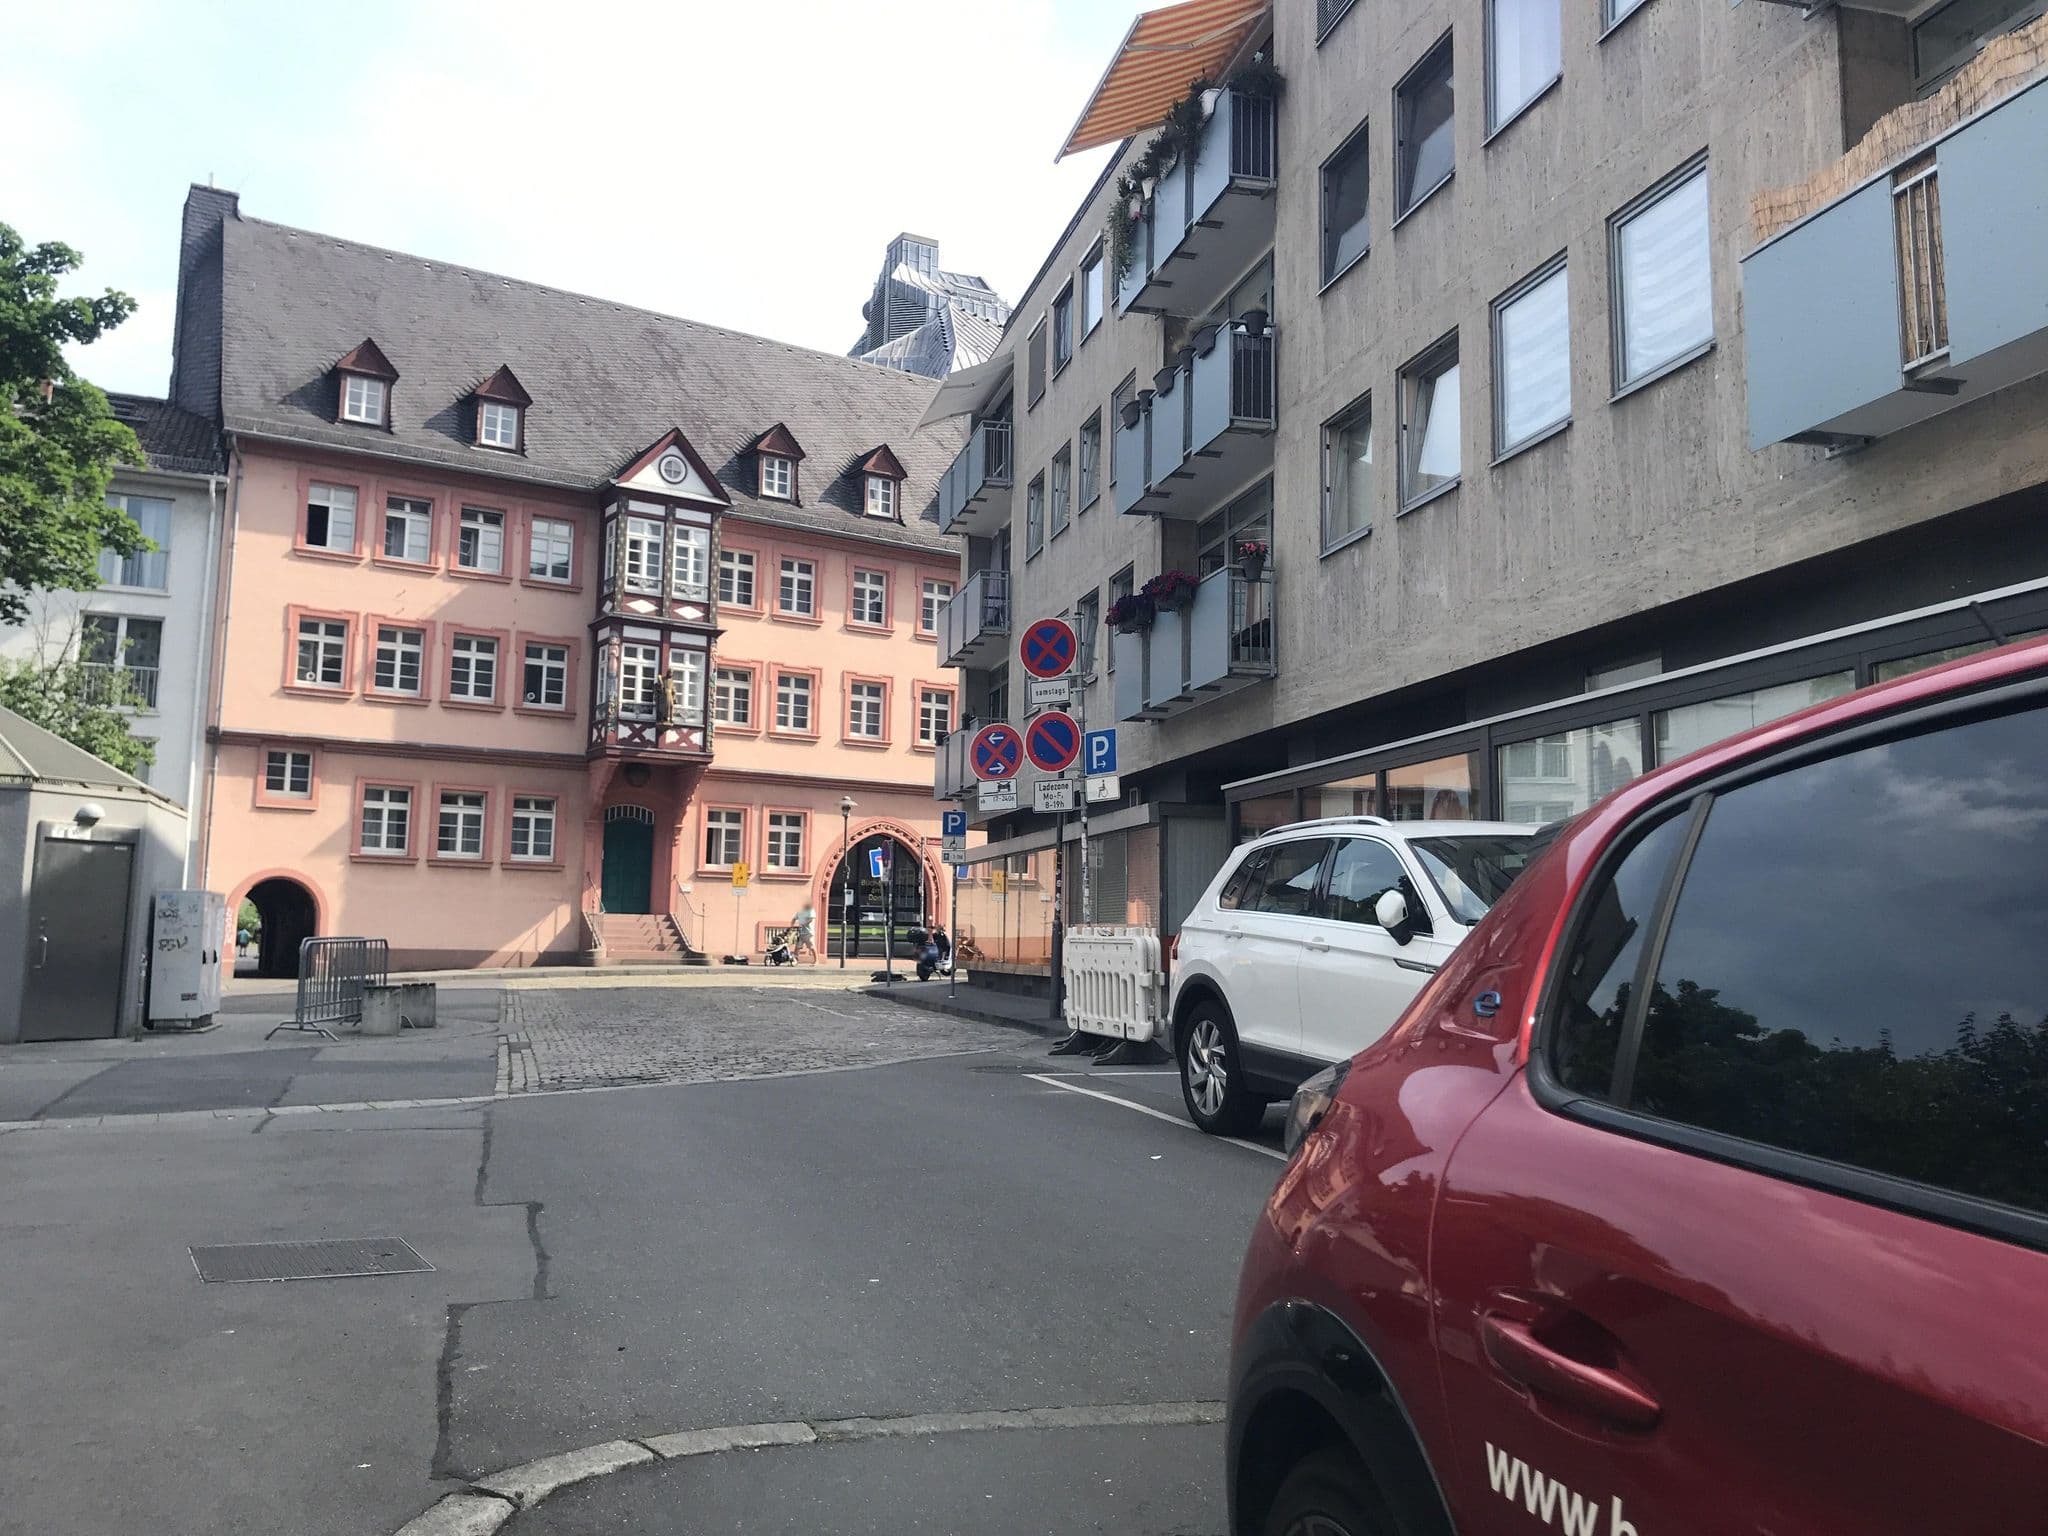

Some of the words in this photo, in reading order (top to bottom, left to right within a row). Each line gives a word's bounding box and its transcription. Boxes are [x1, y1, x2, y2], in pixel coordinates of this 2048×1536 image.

[1035, 687, 1066, 697] samstags
[1092, 735, 1109, 769] P
[1038, 783, 1069, 792] Ladezone
[1045, 800, 1065, 809] 8-19h
[948, 814, 962, 832] P
